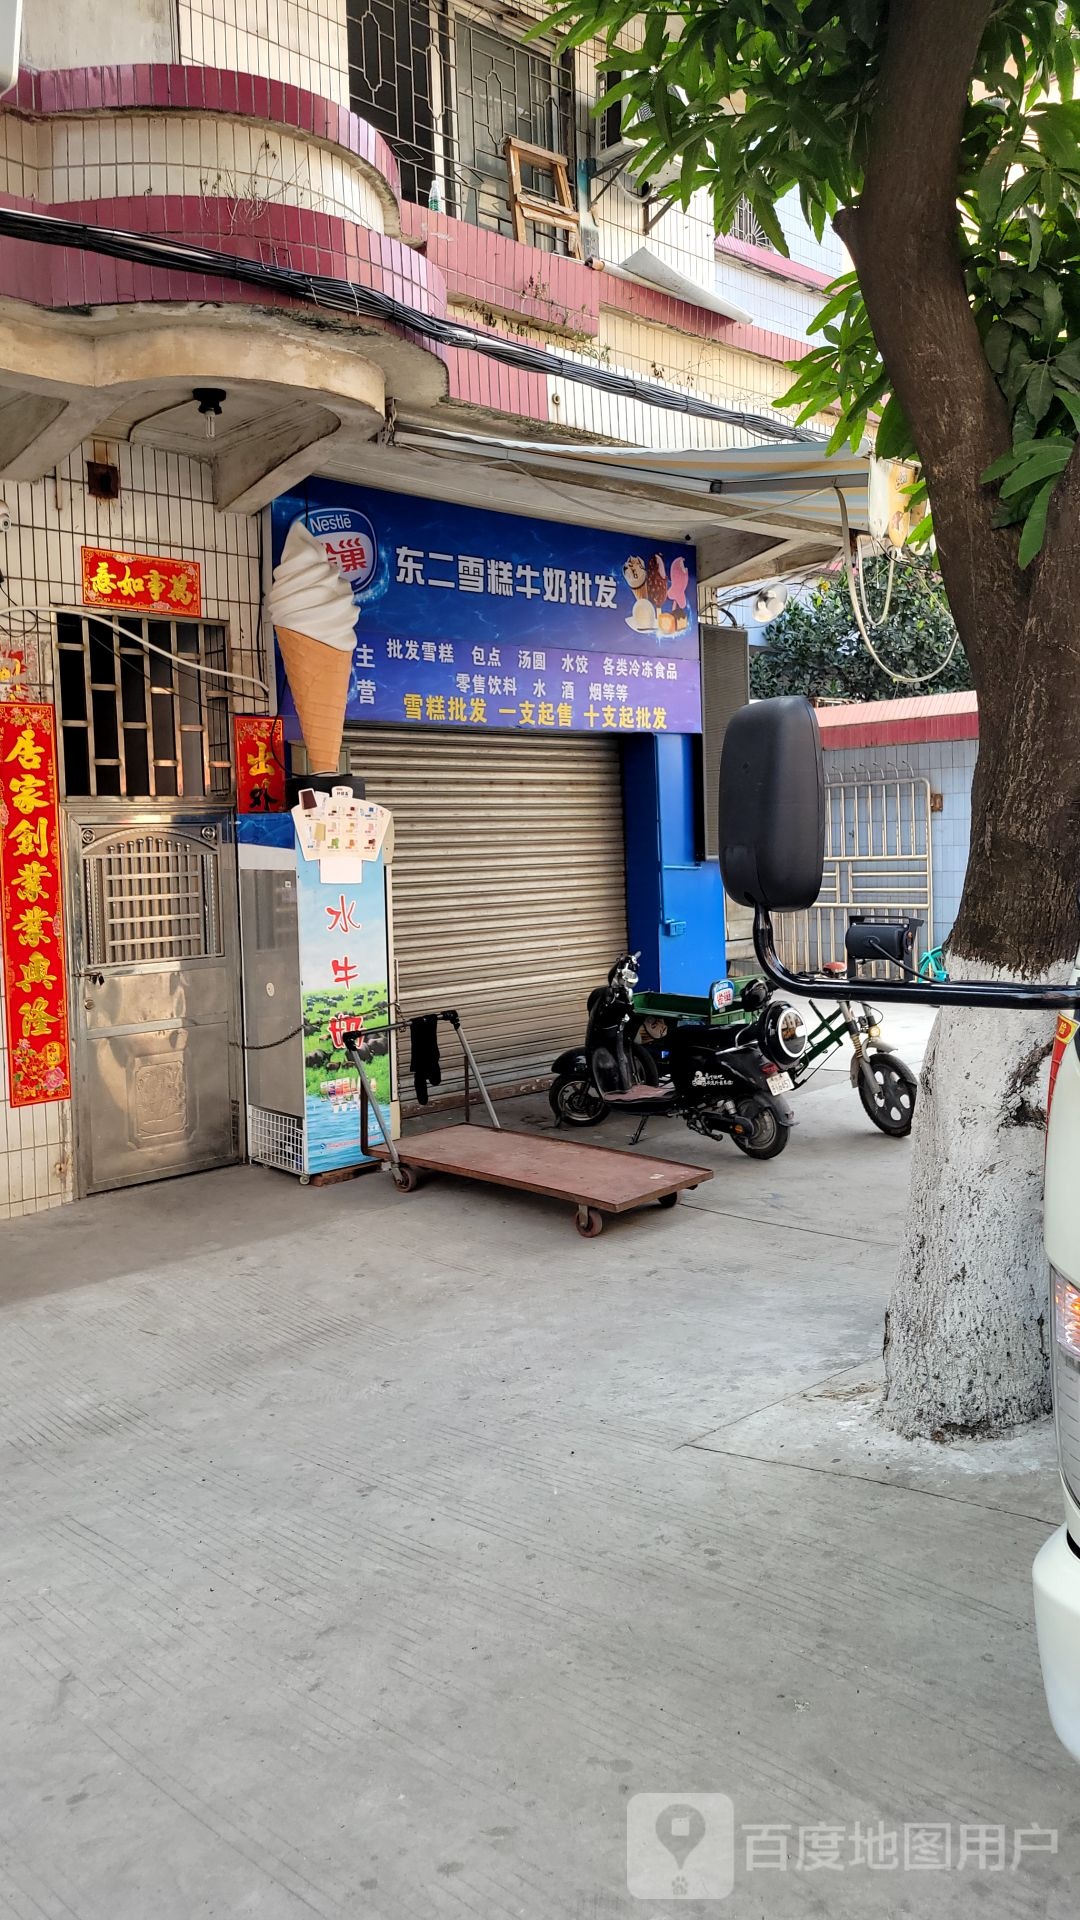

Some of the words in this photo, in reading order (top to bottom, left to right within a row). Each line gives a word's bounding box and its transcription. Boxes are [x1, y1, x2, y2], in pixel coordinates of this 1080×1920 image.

[395, 546, 618, 609] 东二雪糕牛奶批发
[386, 638, 454, 664] 批发雪糕
[471, 646, 501, 667] 包点
[518, 650, 546, 671] 汤圆
[561, 654, 589, 674] 水饺
[603, 656, 678, 681] 各类冷冻食品
[455, 673, 518, 697] 零售饮料
[532, 678, 547, 698] 水
[561, 681, 575, 700] 酒
[588, 682, 629, 703] 烟等等
[403, 692, 488, 724] 雪糕批发
[498, 700, 573, 728] 一支起售
[583, 703, 668, 731] 十支起批发
